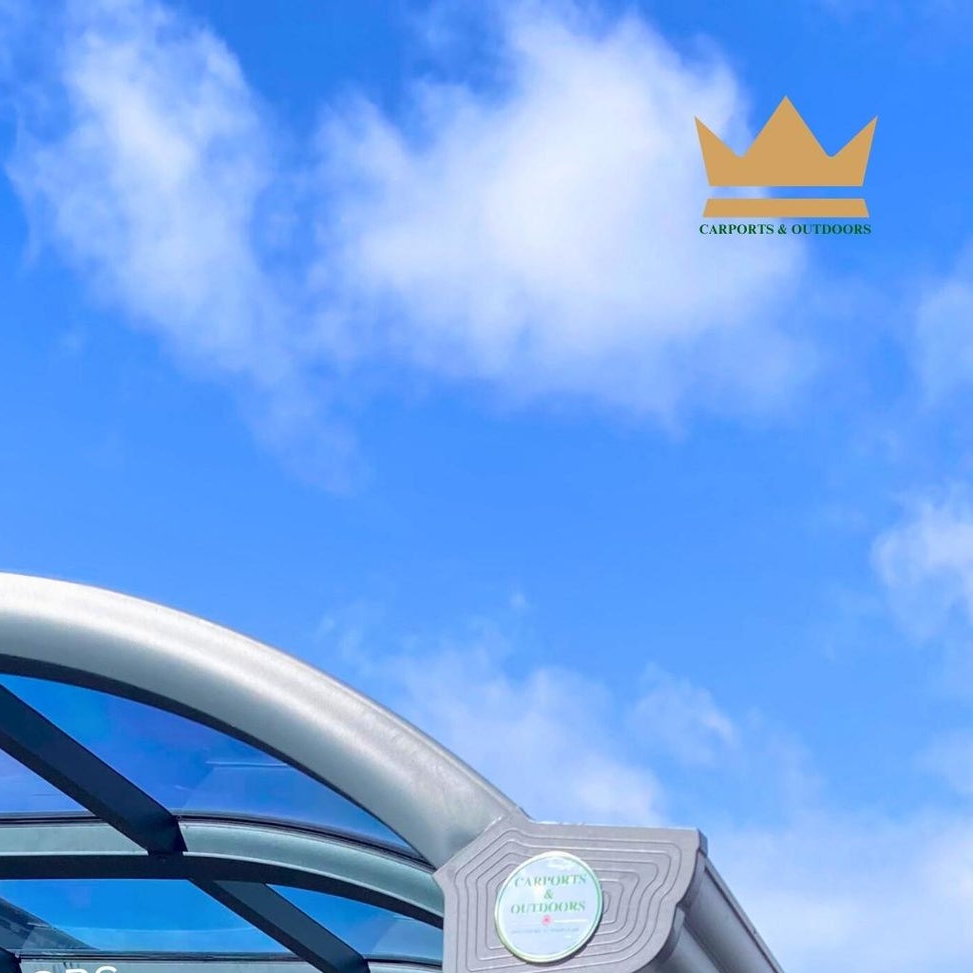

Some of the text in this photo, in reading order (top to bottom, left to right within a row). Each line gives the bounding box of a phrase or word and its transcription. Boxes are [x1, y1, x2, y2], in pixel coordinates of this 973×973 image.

[514, 874, 587, 887] CARPORTS
[543, 889, 554, 900] &
[510, 901, 585, 914] OUTDOORS
